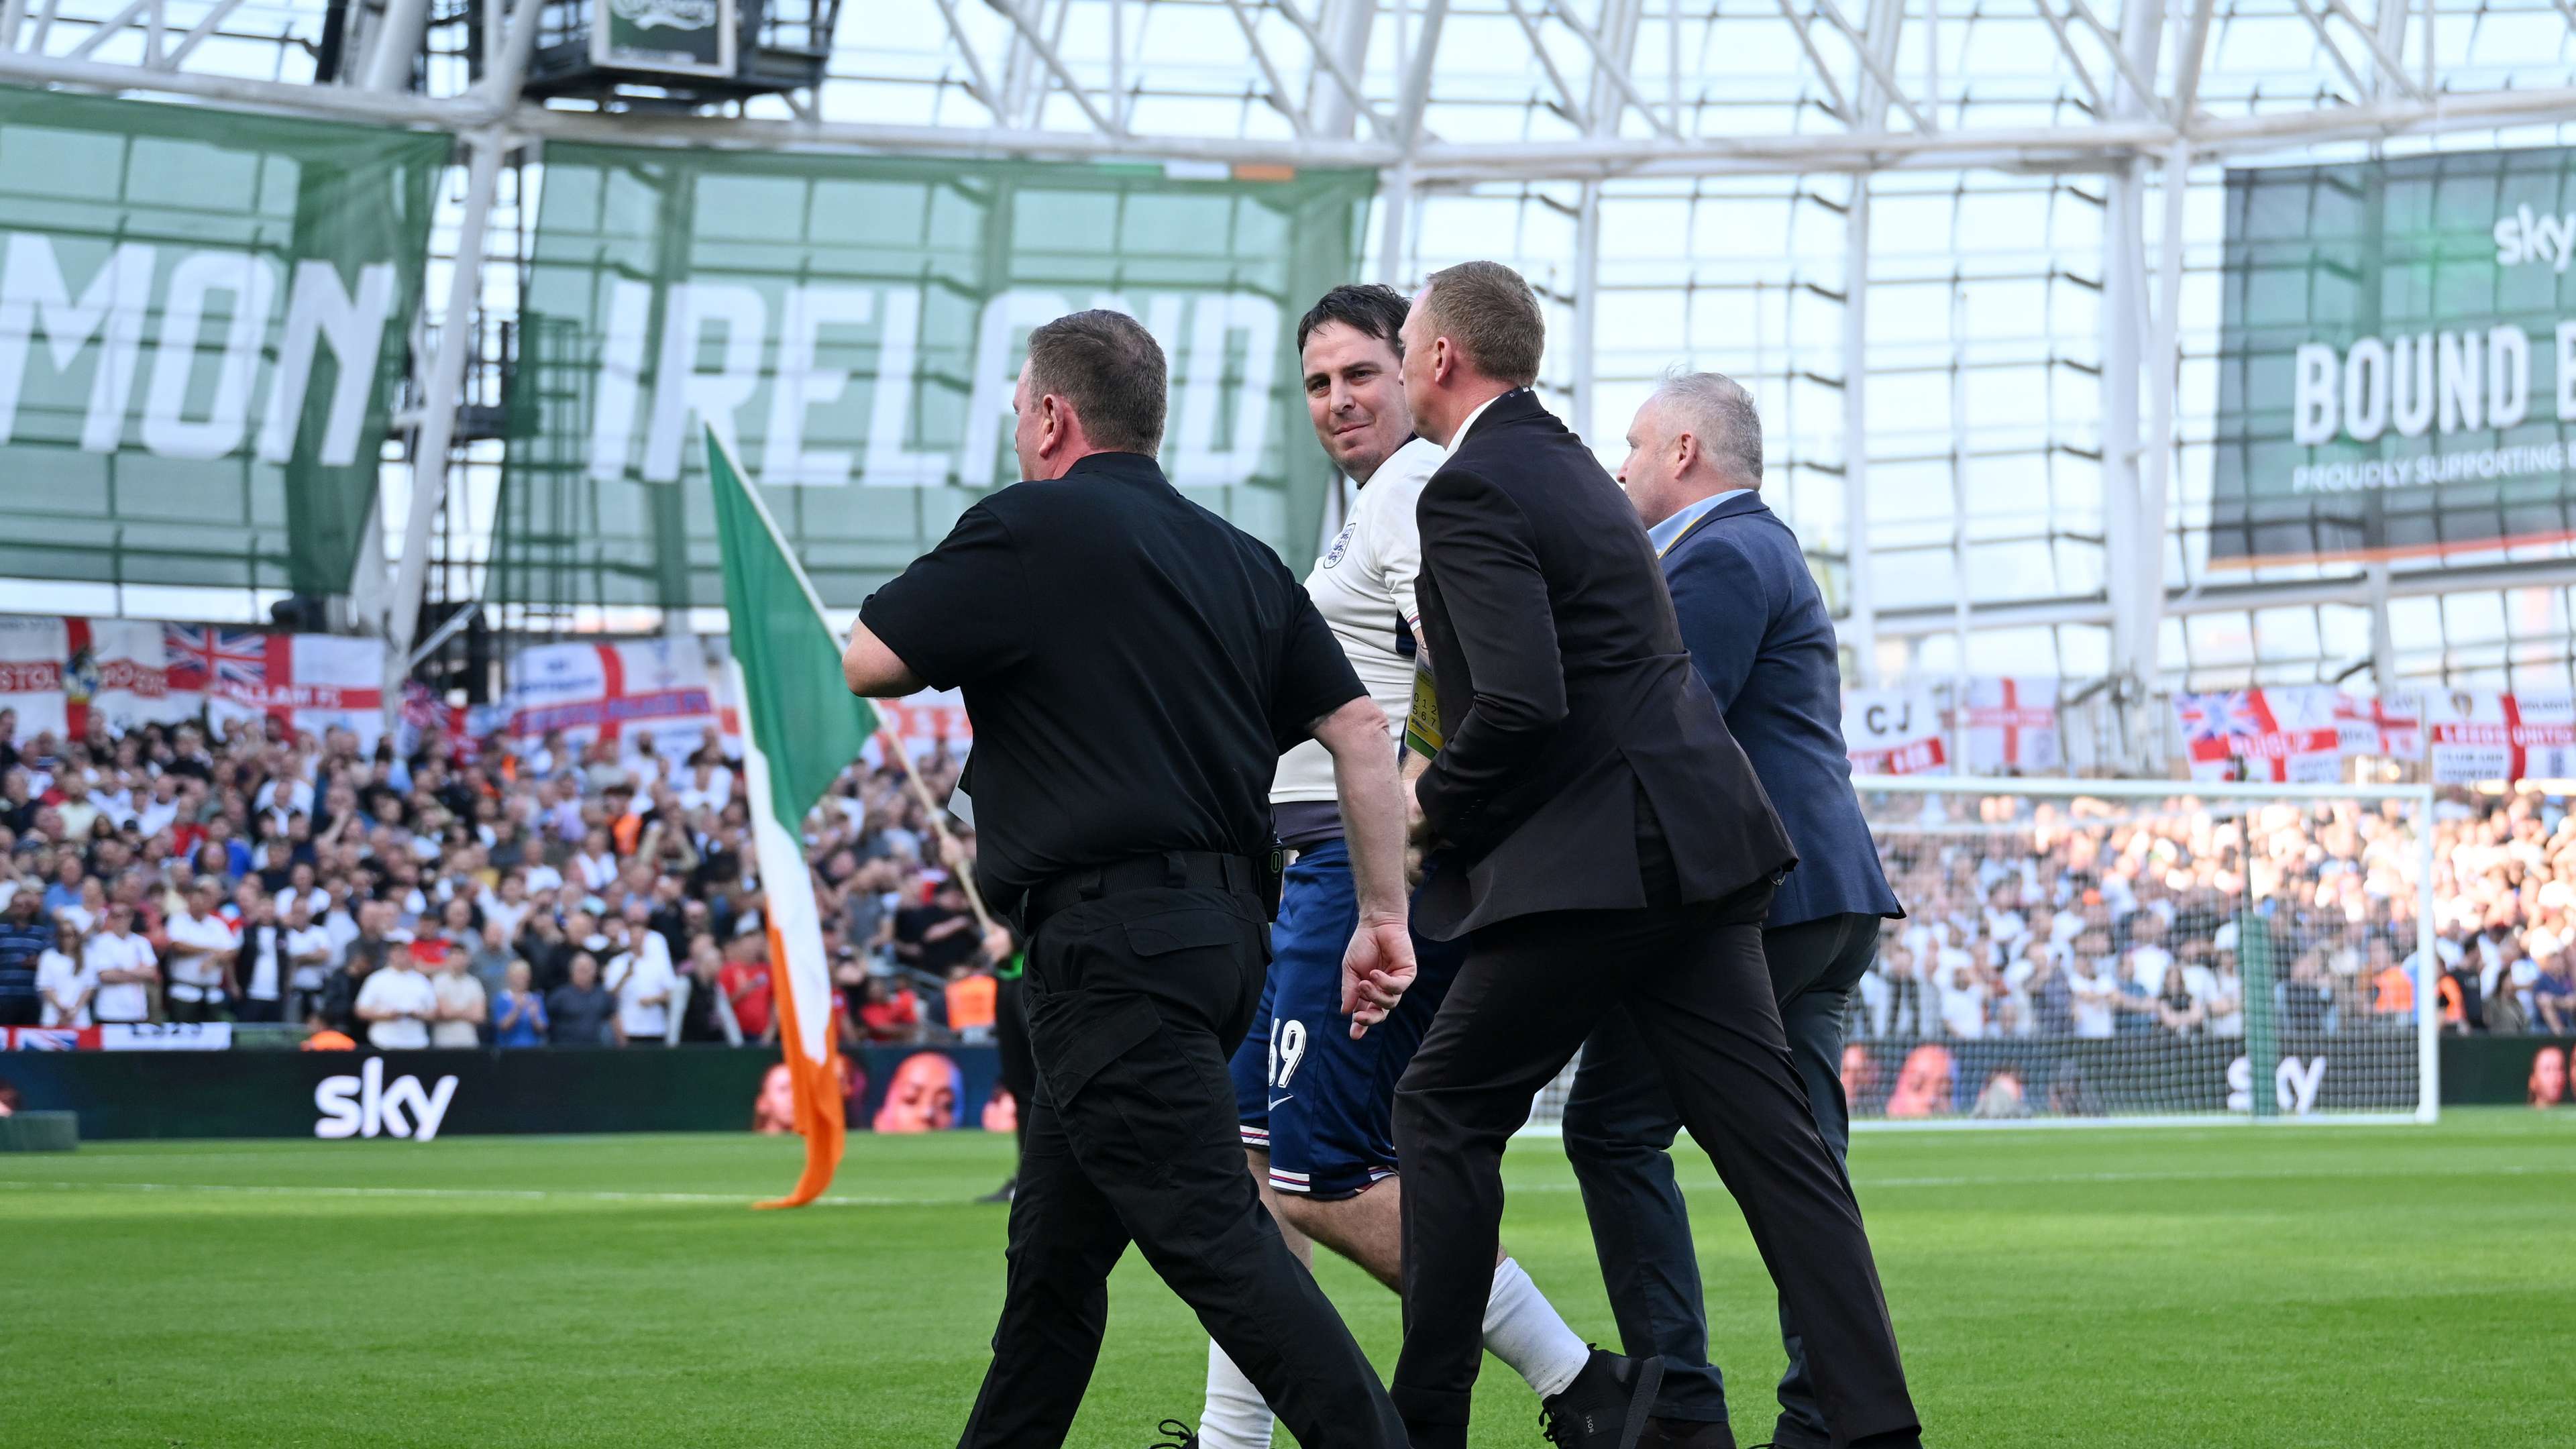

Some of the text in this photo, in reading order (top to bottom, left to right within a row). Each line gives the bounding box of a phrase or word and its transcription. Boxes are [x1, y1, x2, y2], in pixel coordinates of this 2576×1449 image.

[2493, 203, 2576, 273] sky
[2293, 325, 2530, 446] BOUND
[2292, 458, 2411, 494] PROUDLY
[2415, 441, 2562, 485] SUPPORTING
[1421, 711, 1427, 720] 6
[1422, 699, 1427, 709] 1
[1431, 705, 1437, 715] 2
[315, 1056, 459, 1142] sky
